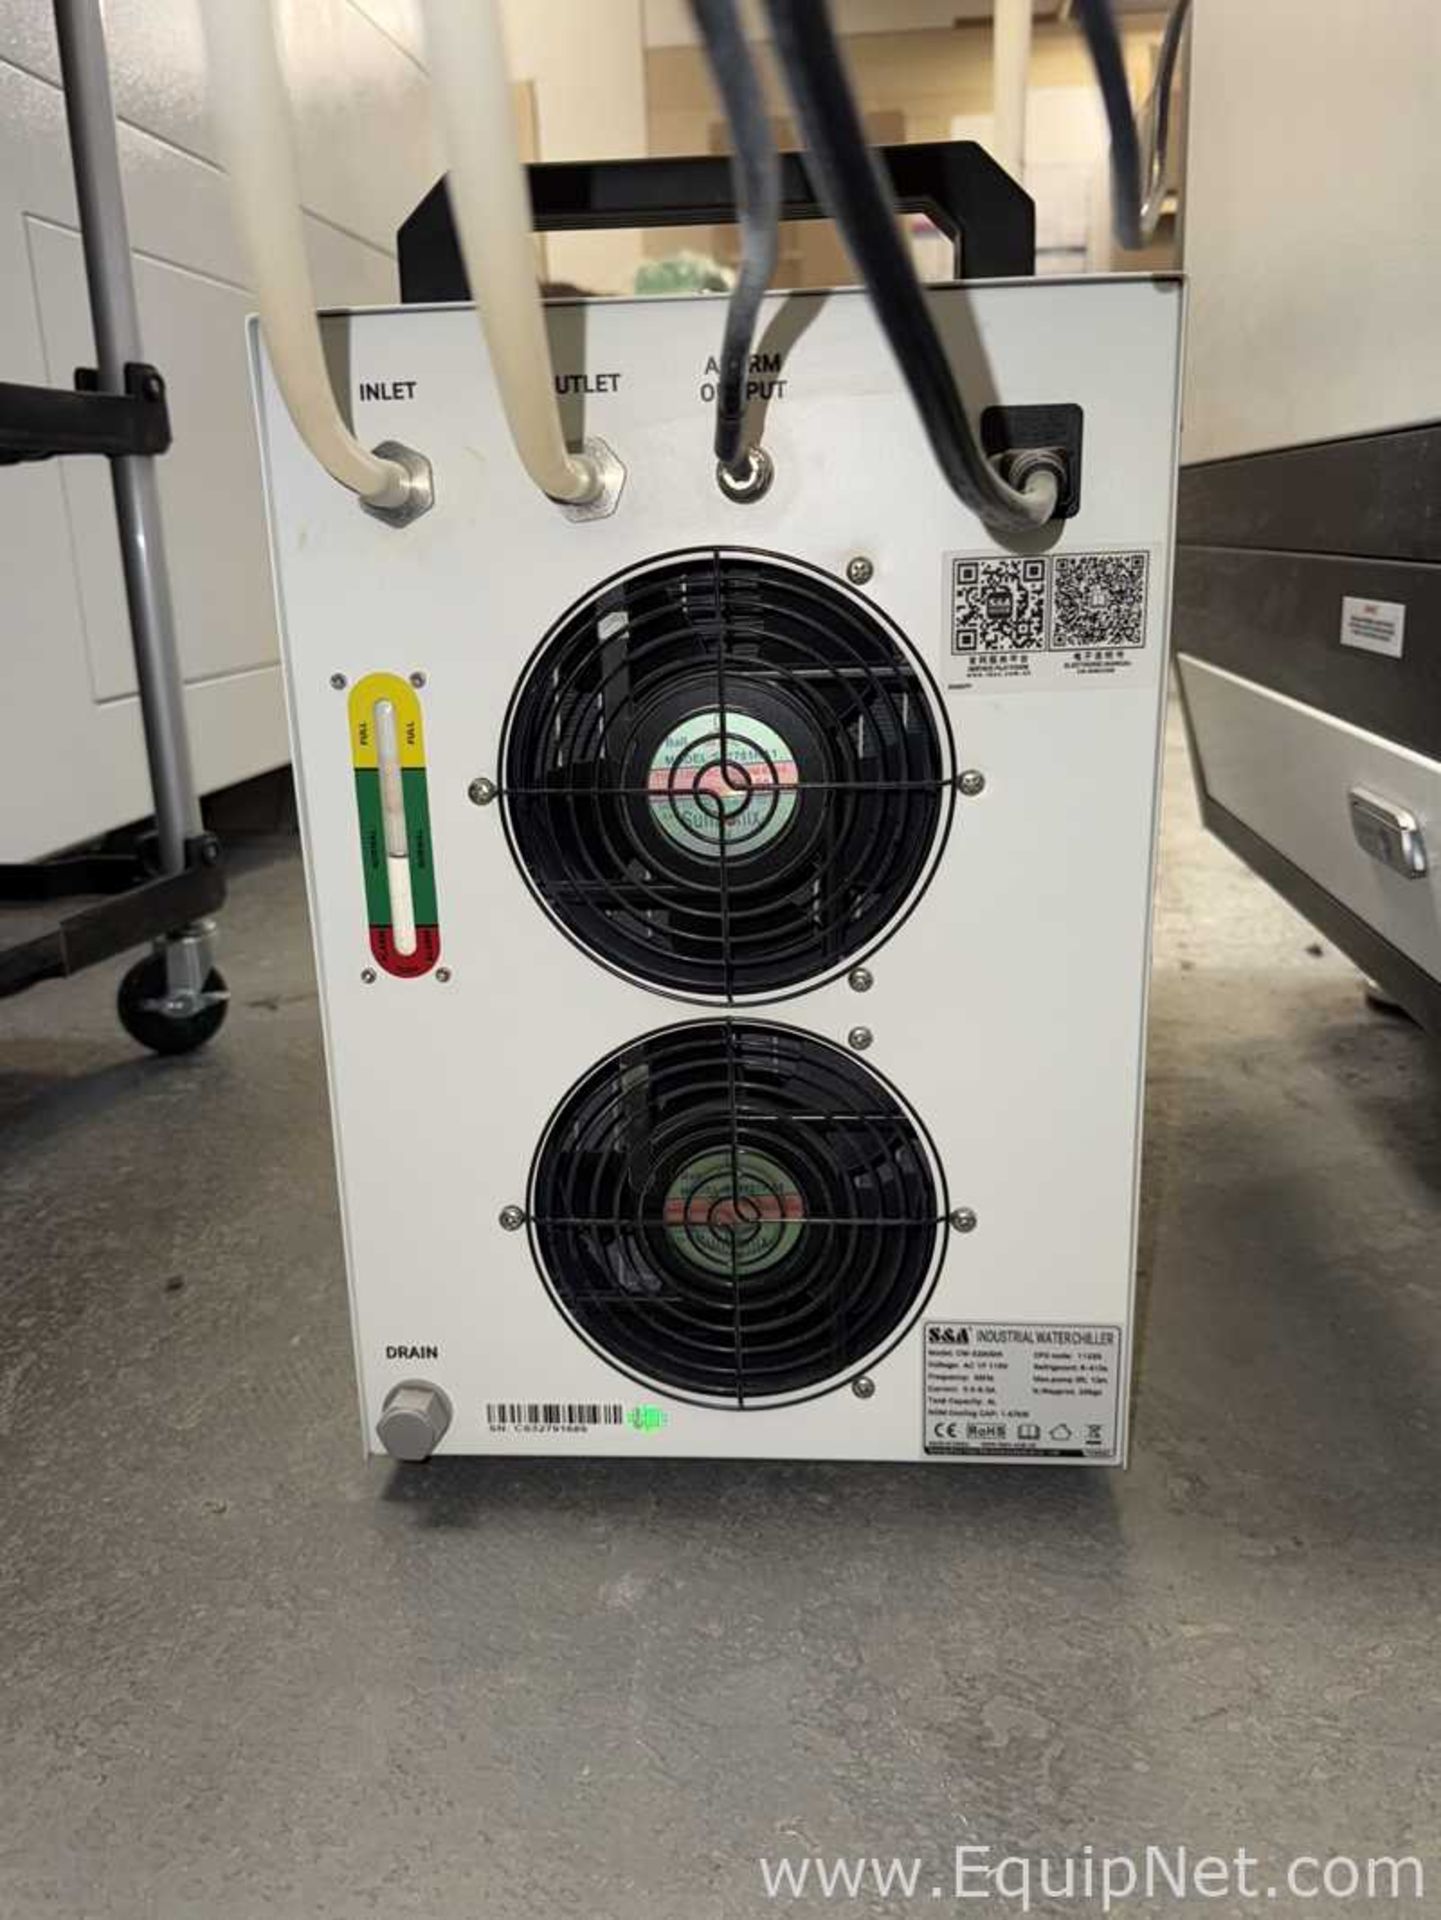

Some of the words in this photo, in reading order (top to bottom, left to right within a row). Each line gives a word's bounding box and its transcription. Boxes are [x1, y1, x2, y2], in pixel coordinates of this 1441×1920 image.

[705, 353, 782, 374] ARM
[359, 381, 416, 401] INLET
[554, 374, 621, 395] UTLET
[700, 381, 788, 402] OPUT
[359, 720, 368, 746] FULL
[406, 721, 415, 745] FULL
[929, 1327, 969, 1344] S&A
[976, 1328, 1034, 1343] INDUSTRIAL
[386, 1346, 438, 1359] DRAIN
